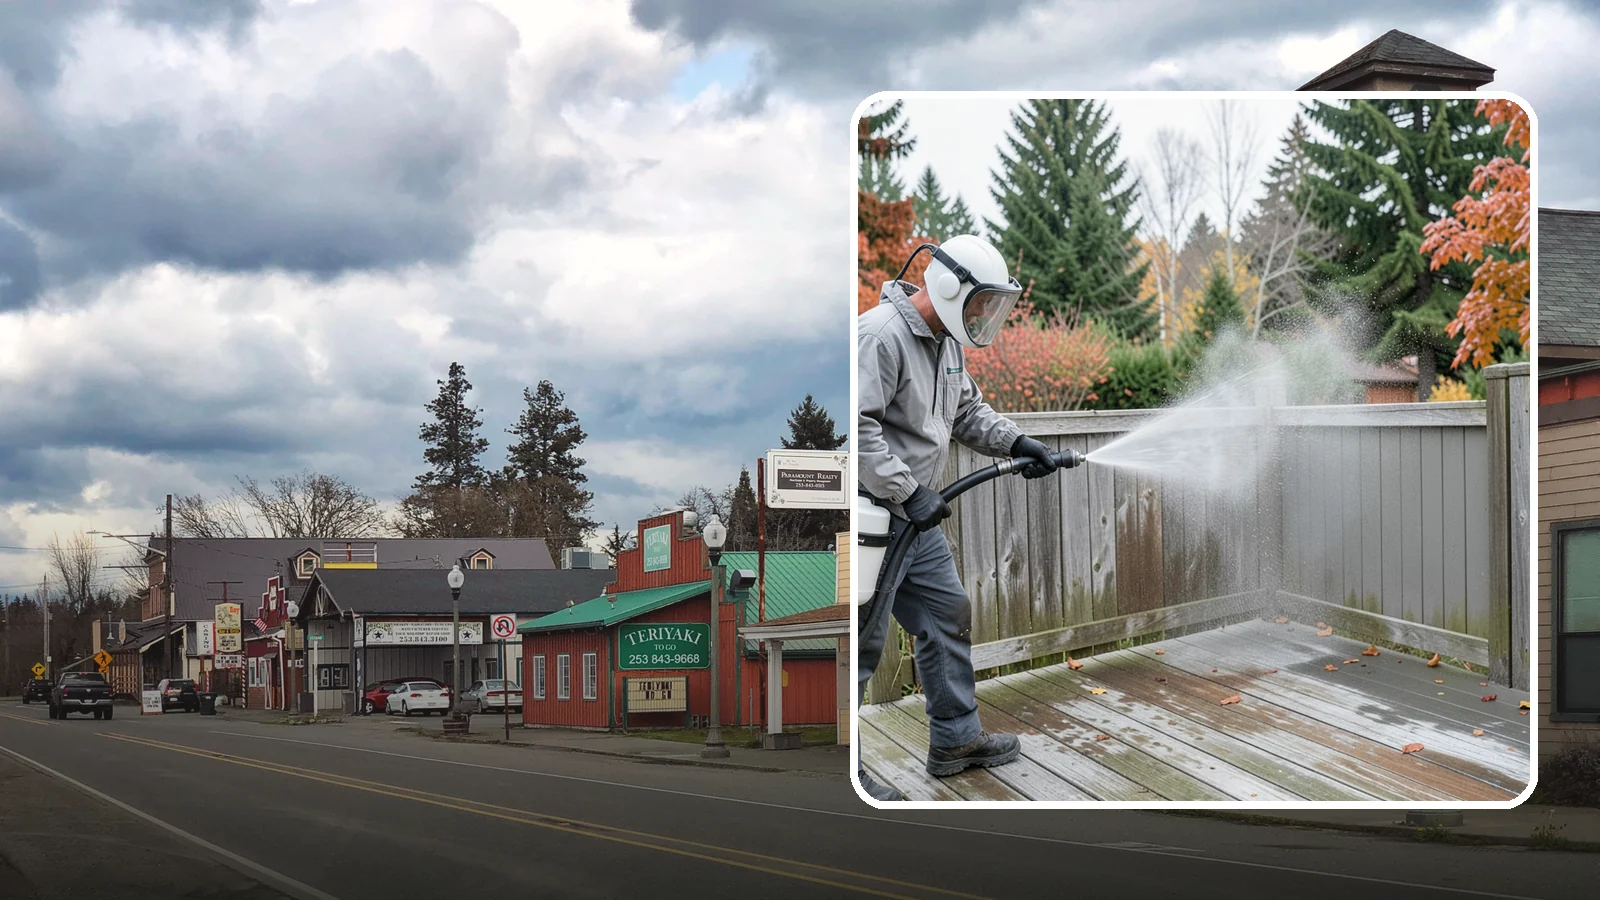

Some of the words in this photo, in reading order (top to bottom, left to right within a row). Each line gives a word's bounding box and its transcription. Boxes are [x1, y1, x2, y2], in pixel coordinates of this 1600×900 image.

[646, 531, 669, 549] TERIYAKI
[625, 627, 702, 646] TERIYAKI
[629, 654, 649, 664] 253
[651, 653, 700, 664] 843-9668
